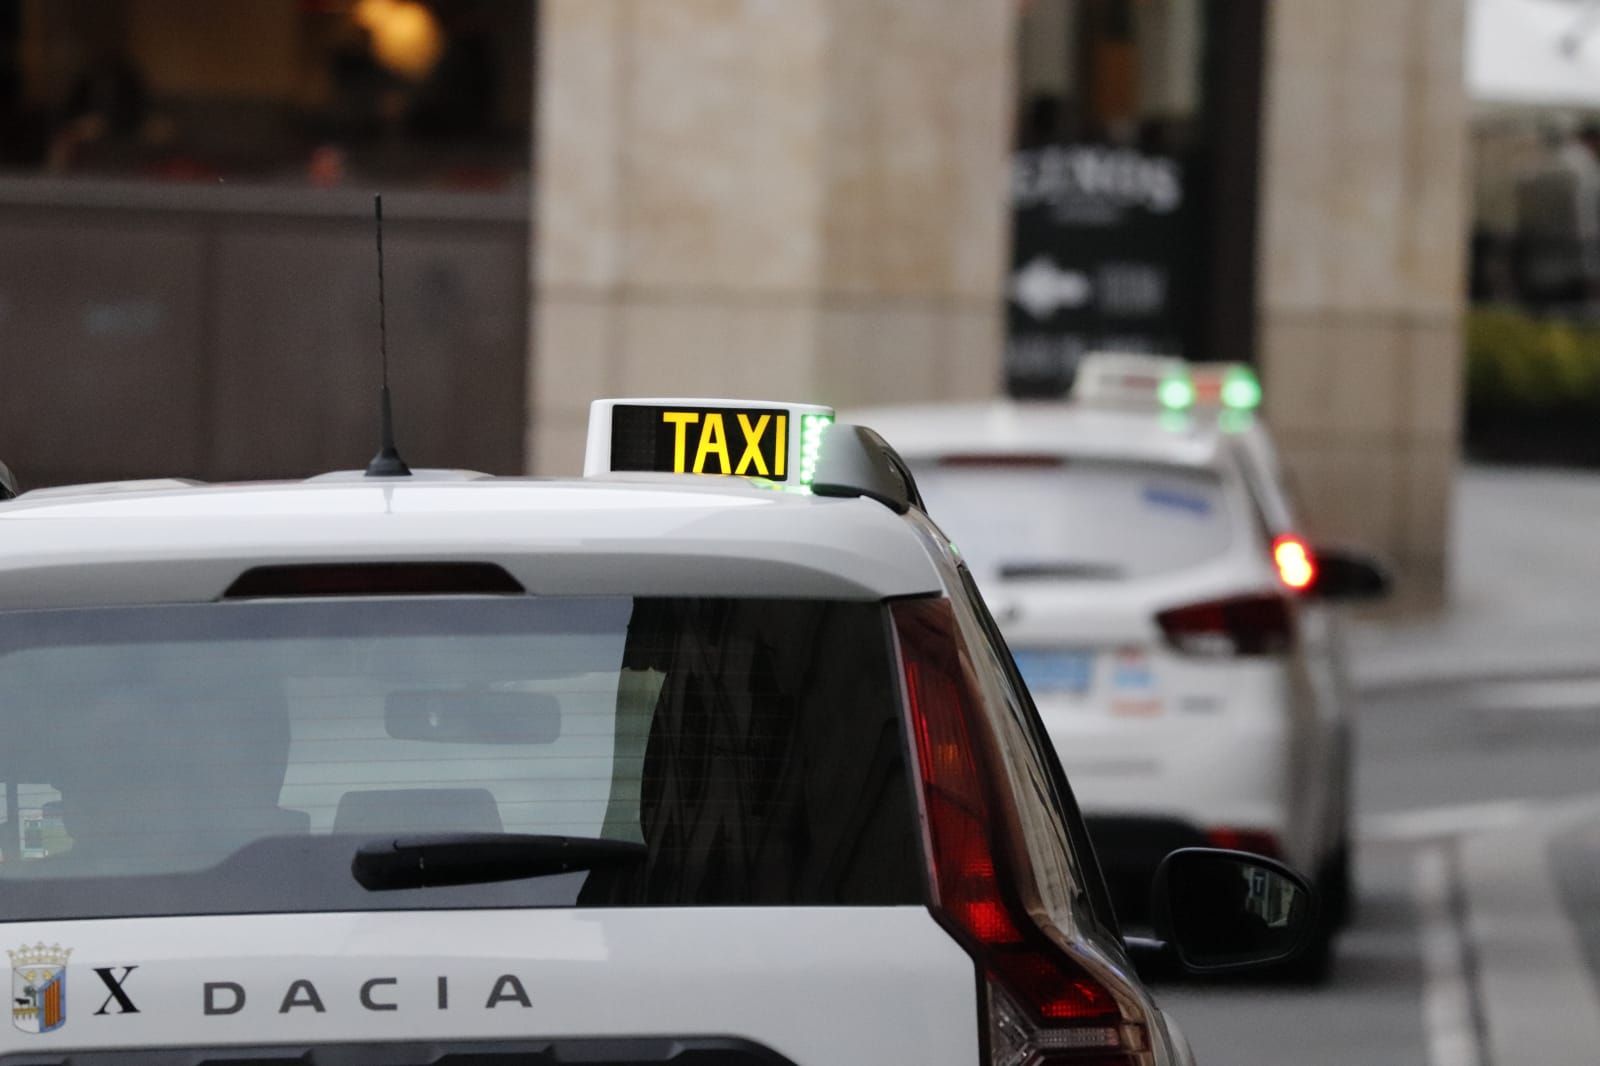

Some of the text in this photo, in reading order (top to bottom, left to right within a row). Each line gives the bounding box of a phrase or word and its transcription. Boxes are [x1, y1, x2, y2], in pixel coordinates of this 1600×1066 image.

[663, 412, 787, 475] TAXI
[92, 965, 141, 1015] X
[203, 974, 533, 1016] DACIA
